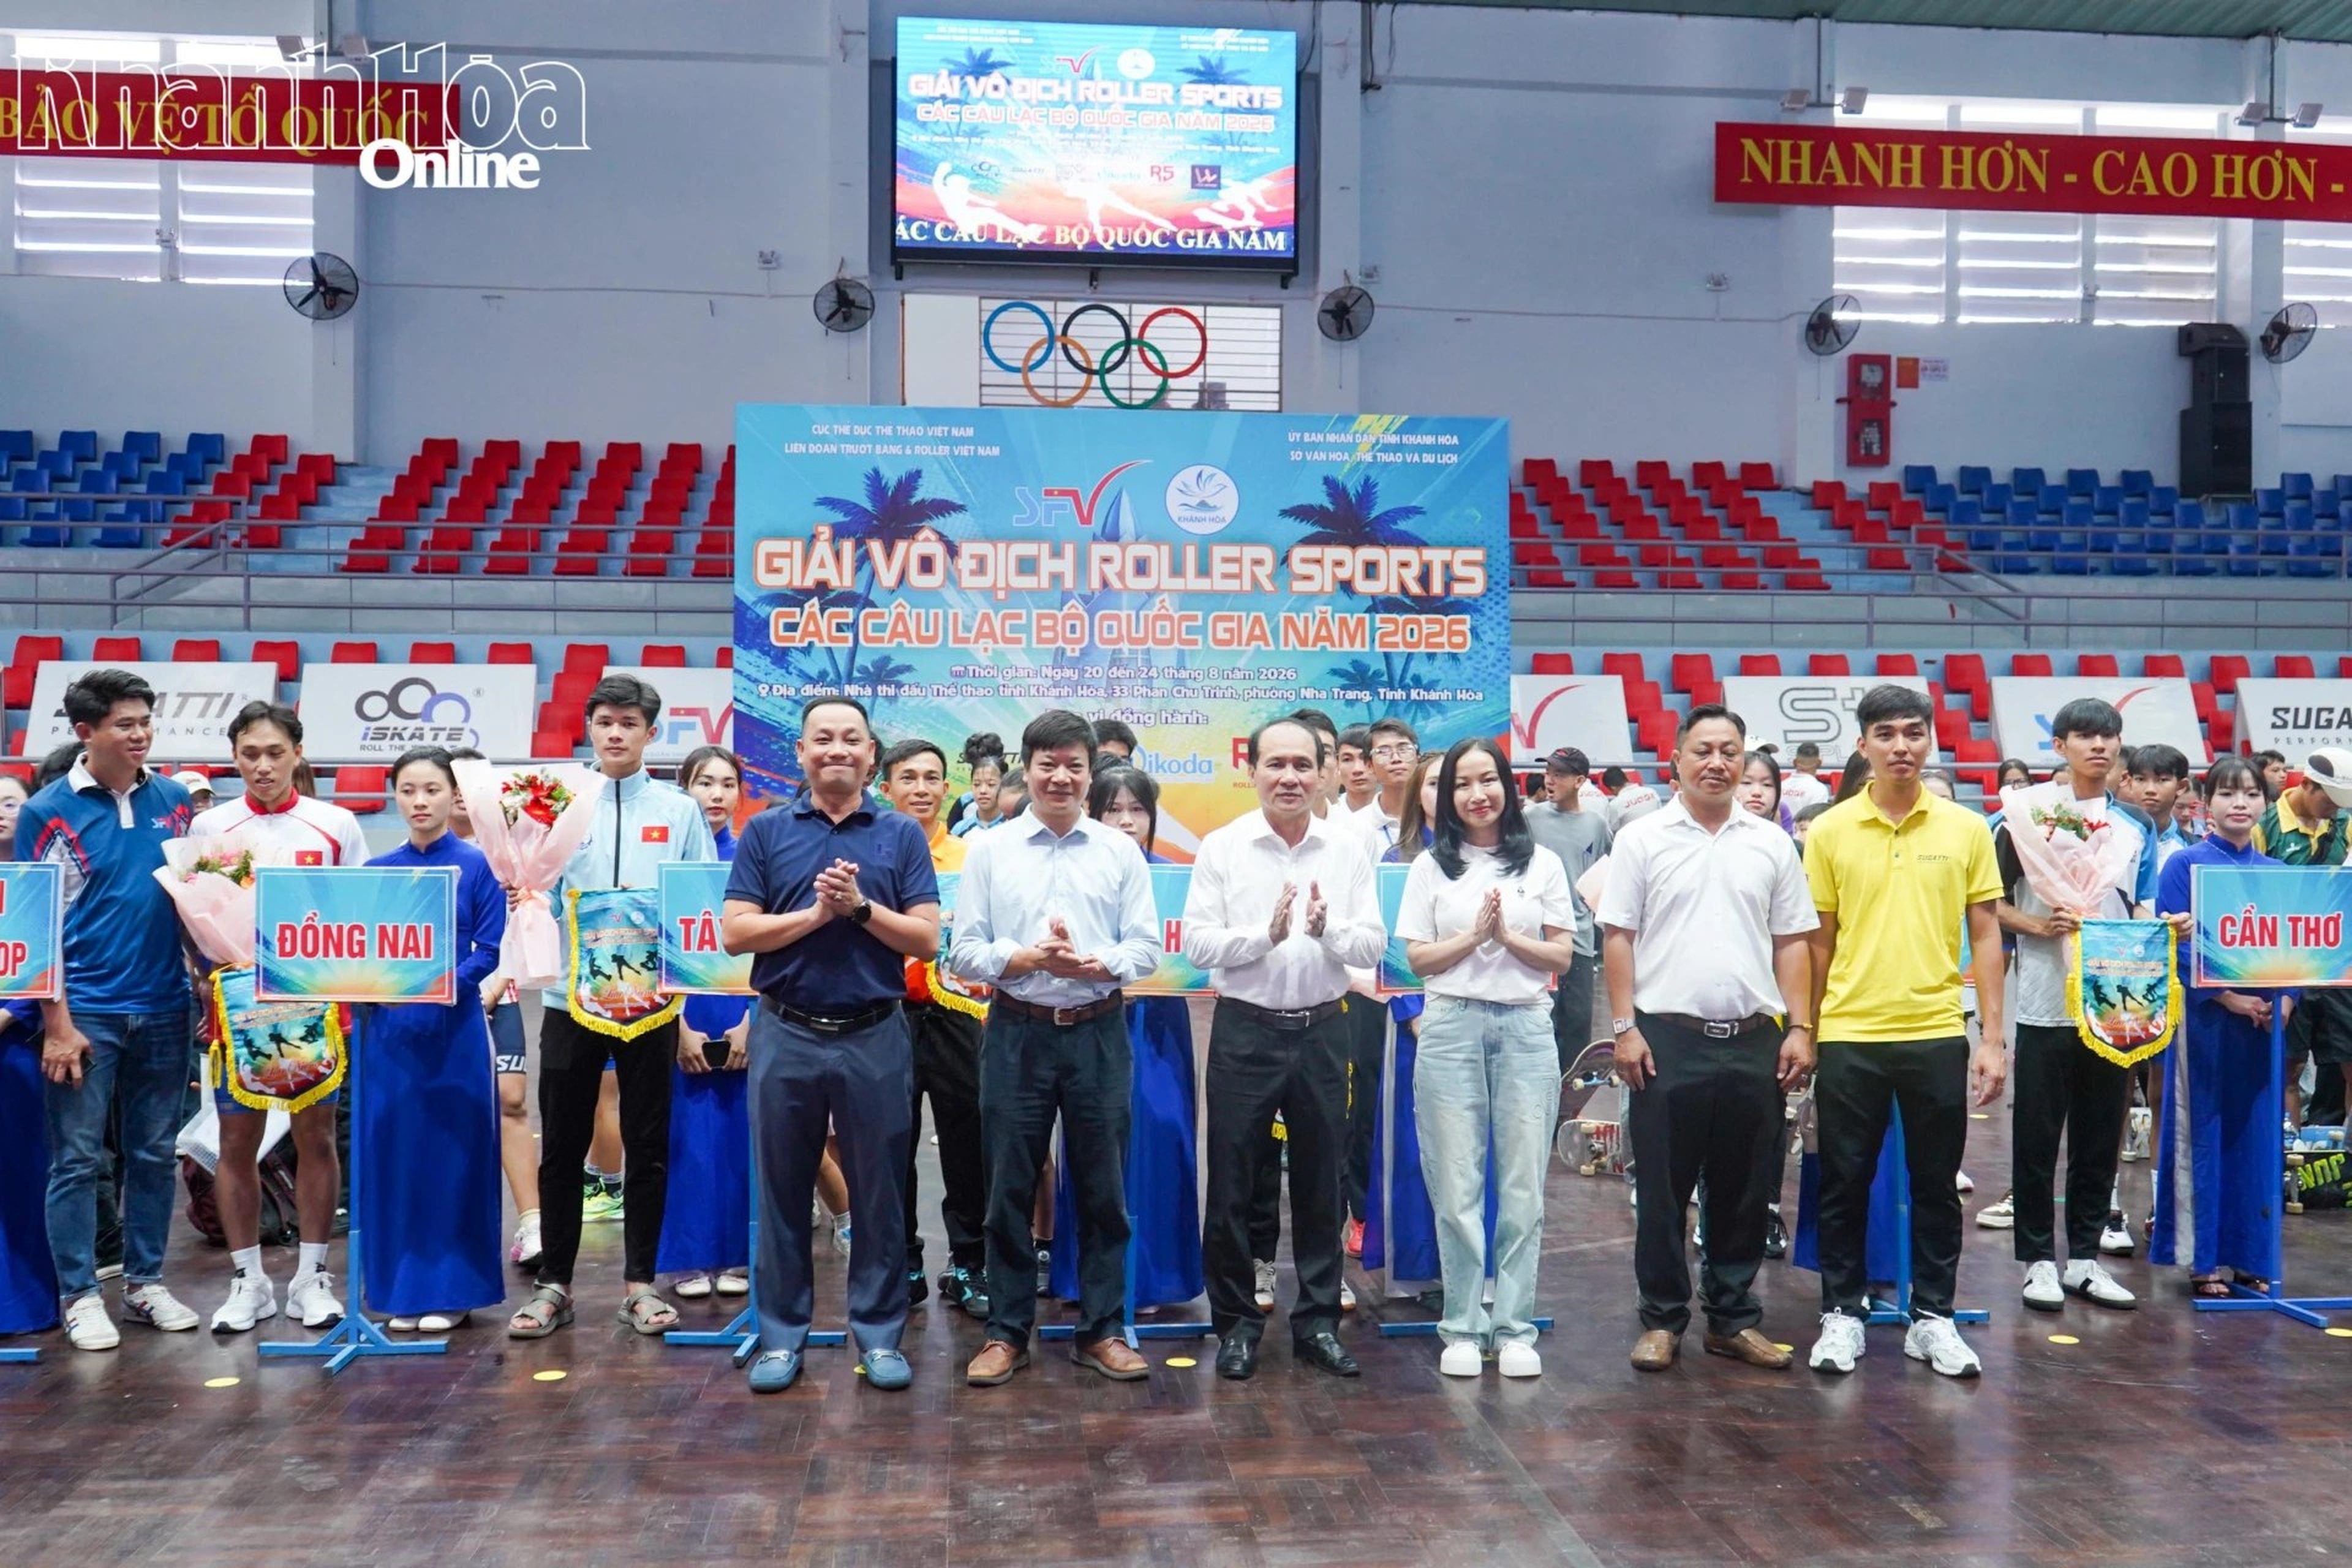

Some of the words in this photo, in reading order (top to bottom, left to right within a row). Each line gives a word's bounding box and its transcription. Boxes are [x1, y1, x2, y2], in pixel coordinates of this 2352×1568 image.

[966, 72, 1006, 99] VÔ
[1078, 80, 1174, 105] ROLLER
[1180, 83, 1283, 108] SPORTS
[0, 84, 99, 140] BẢO
[113, 89, 183, 156] VỆ
[281, 89, 429, 157] QUỐC
[917, 99, 960, 122] CÁC
[1139, 109, 1172, 128] GIA
[1224, 115, 1274, 132] 2026
[1740, 138, 1926, 188] NHANH
[1939, 140, 2050, 193] HƠN
[2092, 151, 2198, 198] CAO
[2211, 149, 2318, 203] HƠN
[1176, 228, 1223, 249] GIA
[895, 426, 924, 437] THAO
[951, 427, 974, 437] NAM
[1303, 432, 1325, 443] BAN
[914, 445, 950, 456] ROLLER
[978, 446, 1000, 456] NAM
[1376, 451, 1403, 462] THAO
[1422, 453, 1435, 464] DU
[755, 524, 856, 590] GIẢI
[867, 526, 948, 590] VÔ
[957, 540, 1076, 602] ĐỊCH
[1088, 540, 1278, 593] ROLLER
[1289, 543, 1487, 597] SPORTS
[770, 597, 854, 647] CÁC
[858, 598, 943, 647] CÂU
[948, 608, 1027, 655] LẠC
[1033, 599, 1089, 656] BỘ
[1095, 594, 1202, 655] QUỐC
[1208, 611, 1274, 650] GIA
[1280, 605, 1370, 652] NĂM
[1376, 614, 1471, 653] 2026
[1041, 666, 1079, 680] Ngày
[1084, 666, 1102, 678] 20
[1138, 666, 1159, 679] 24
[1164, 666, 1204, 681] tháng
[1208, 666, 1218, 679] 8
[1259, 668, 1297, 680] 2026
[772, 684, 796, 698] Địa
[844, 684, 872, 697] Nhà
[876, 684, 895, 697] thi
[962, 684, 994, 697] thao
[1030, 684, 1072, 697] Khánh
[1112, 685, 1129, 698] 33
[1134, 685, 1168, 698] Phan
[1172, 685, 1198, 698] Chu
[1300, 687, 1327, 699] Nha
[1410, 688, 1452, 701] Khánh
[1131, 744, 1213, 775] ikoda
[276, 911, 366, 959] ĐỒNG
[377, 924, 433, 960] NAI
[678, 910, 724, 952] TÂ
[2219, 903, 2278, 948] CẦN
[2288, 912, 2343, 948] THƠ
[496, 1055, 527, 1072] SU
